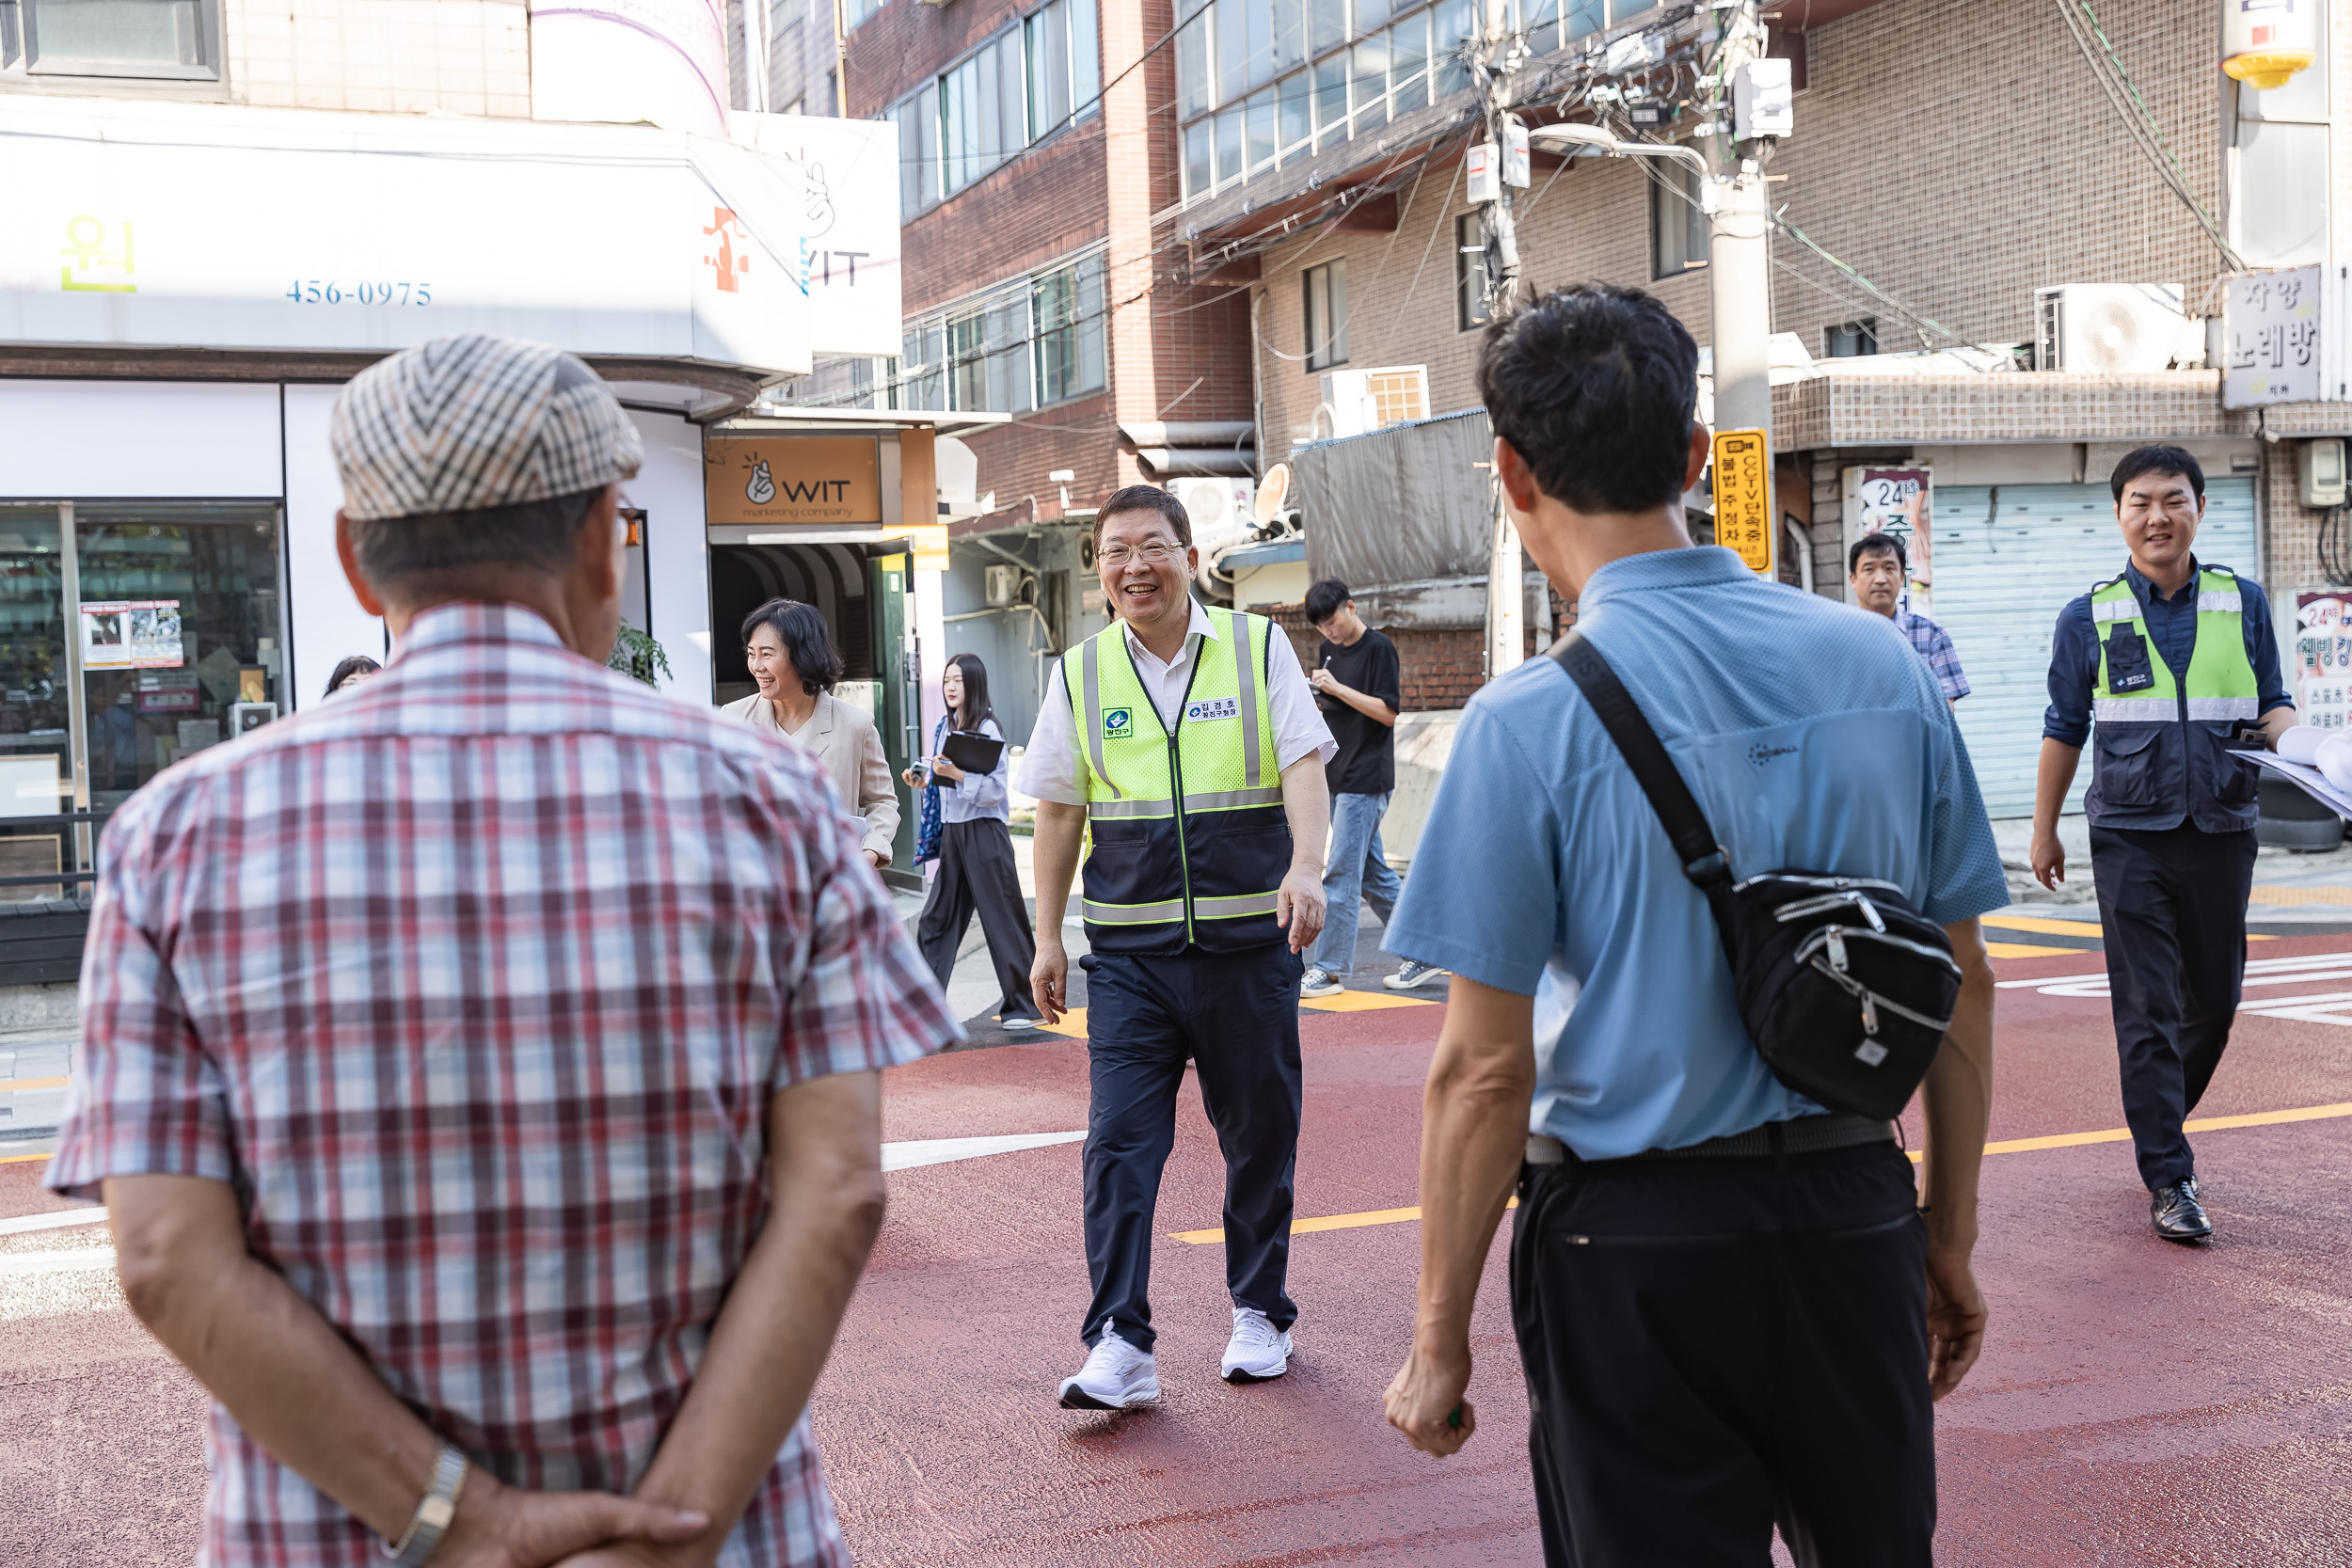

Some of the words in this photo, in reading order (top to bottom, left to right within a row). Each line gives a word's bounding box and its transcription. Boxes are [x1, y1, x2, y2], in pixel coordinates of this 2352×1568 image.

[59, 214, 136, 293] 원
[287, 279, 431, 307] 456-0975
[2232, 321, 2315, 369] 노래방
[782, 480, 850, 503] WIT
[1722, 457, 1739, 541] 불법주정차
[742, 508, 799, 519] marketing
[801, 509, 853, 519] company
[1202, 708, 1236, 718] 광진구청장
